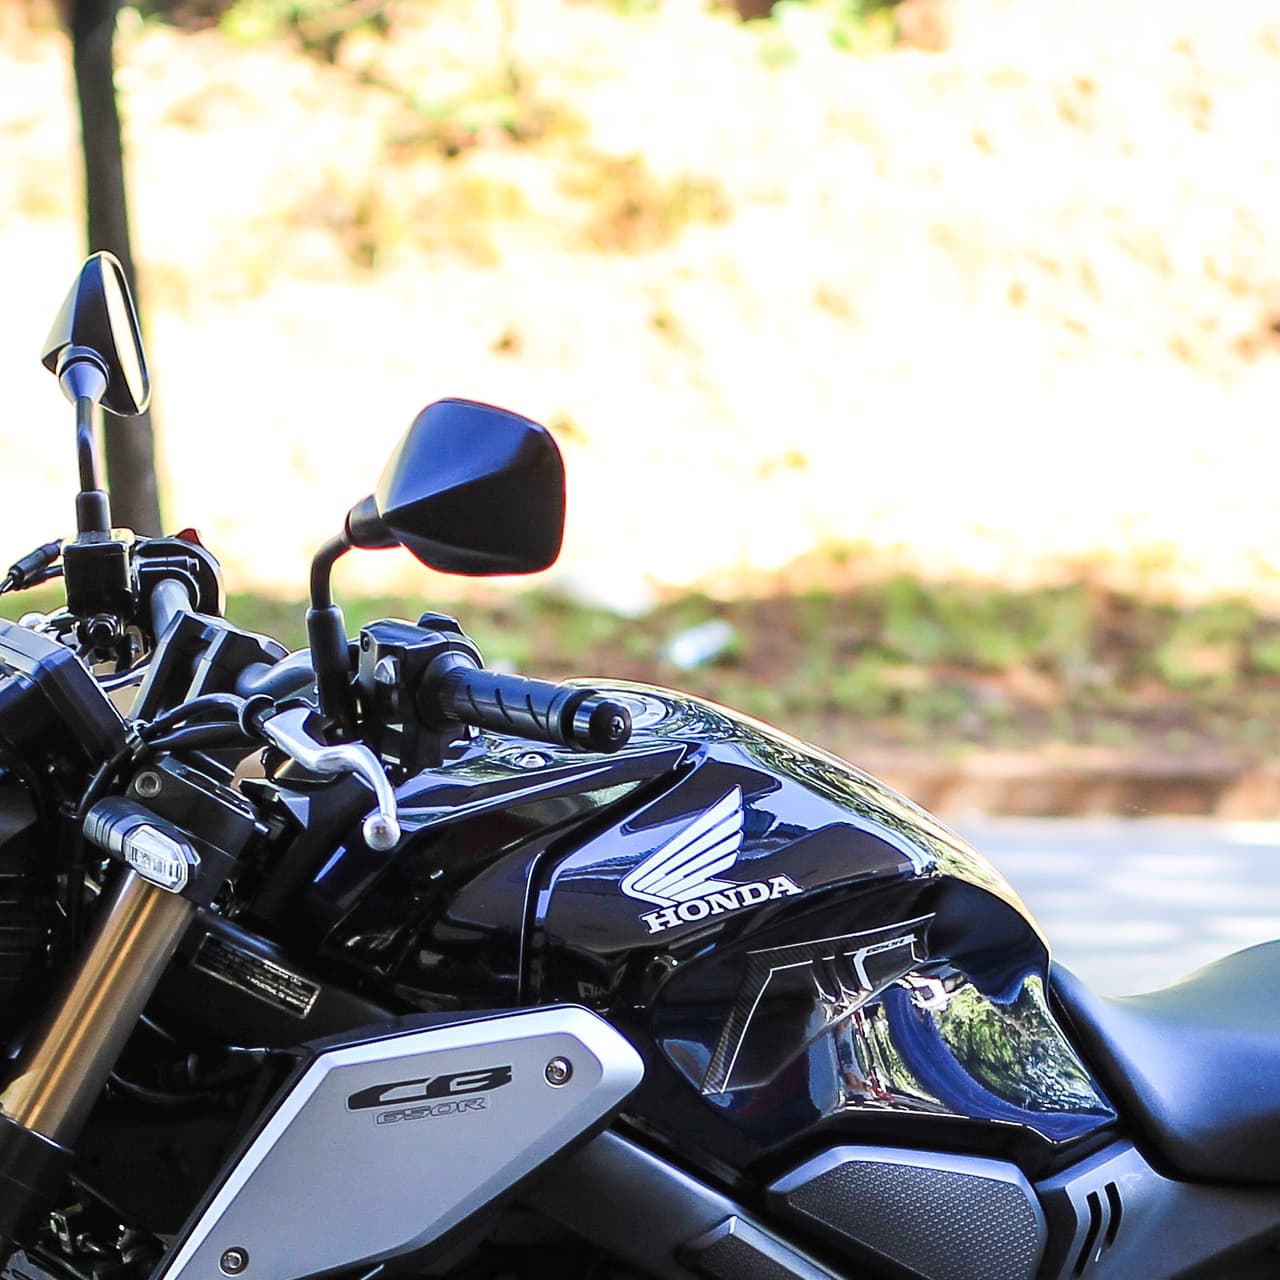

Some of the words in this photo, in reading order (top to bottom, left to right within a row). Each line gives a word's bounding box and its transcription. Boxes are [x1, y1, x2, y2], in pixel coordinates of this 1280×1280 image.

[641, 874, 804, 934] HONDA
[347, 1064, 513, 1110] CB
[376, 1097, 488, 1125] 650R
